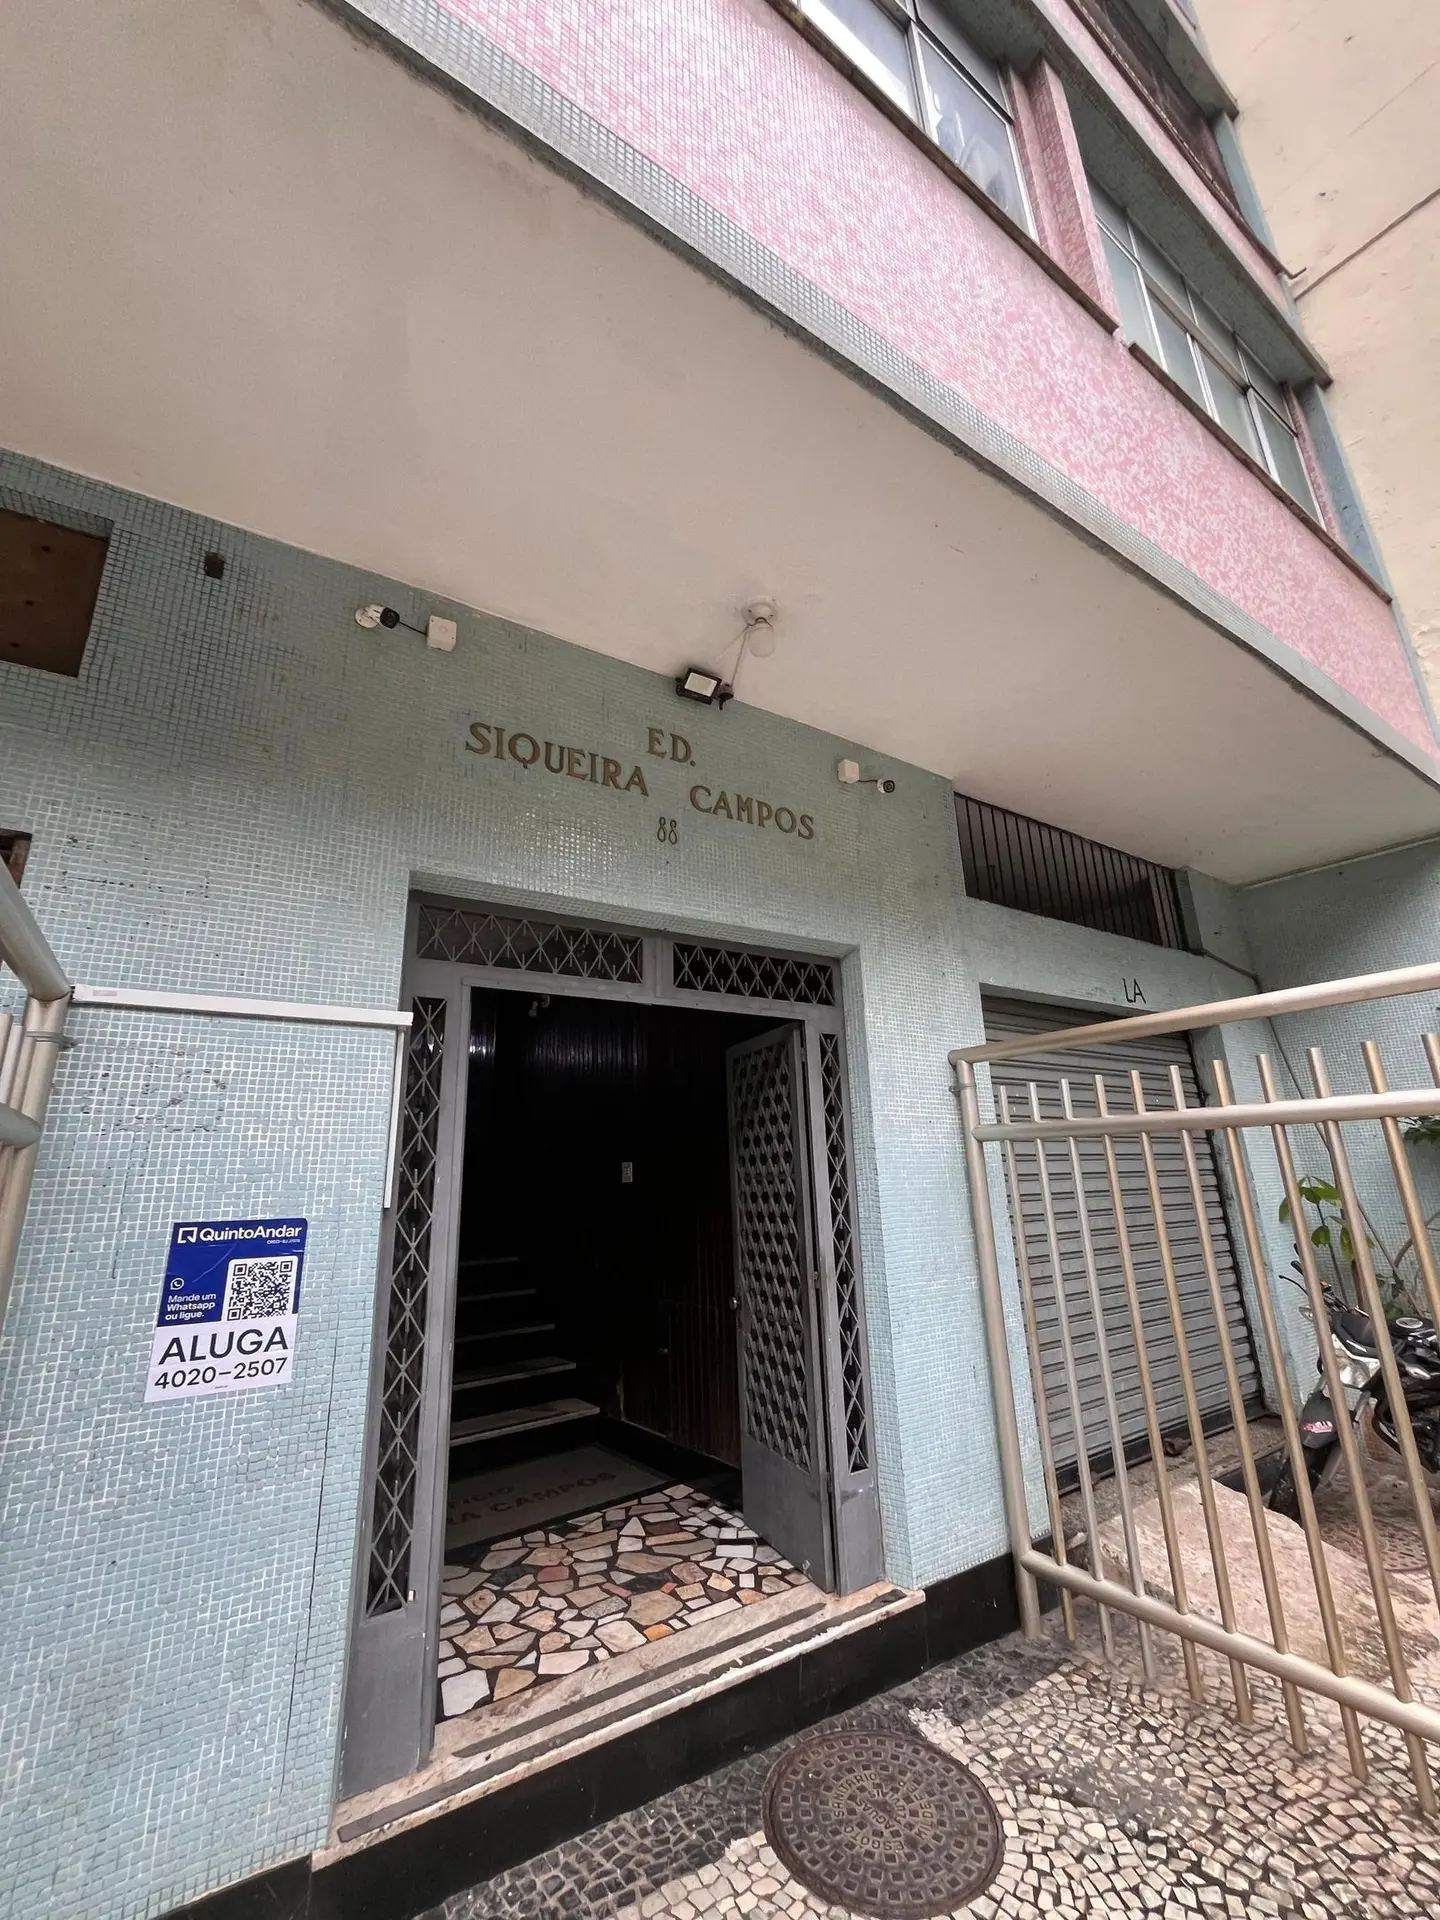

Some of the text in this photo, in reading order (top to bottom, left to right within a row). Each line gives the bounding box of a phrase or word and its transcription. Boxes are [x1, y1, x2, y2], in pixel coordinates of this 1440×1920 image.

[646, 726, 696, 767] ED.
[465, 722, 814, 840] SIQUEIRA CAMPOS
[656, 816, 679, 845] 88
[200, 1225, 303, 1241] QuintoAndar
[167, 1302, 215, 1311] Whatsapp
[168, 1293, 216, 1303] Mande um
[165, 1311, 205, 1321] ou ligue.
[158, 1326, 288, 1365] ALUGA
[154, 1357, 288, 1389] 4020-2507
[490, 1472, 616, 1512] CAMPOS
[855, 1799, 895, 1830] AGUAS
[844, 1825, 905, 1850] ESGOTO
